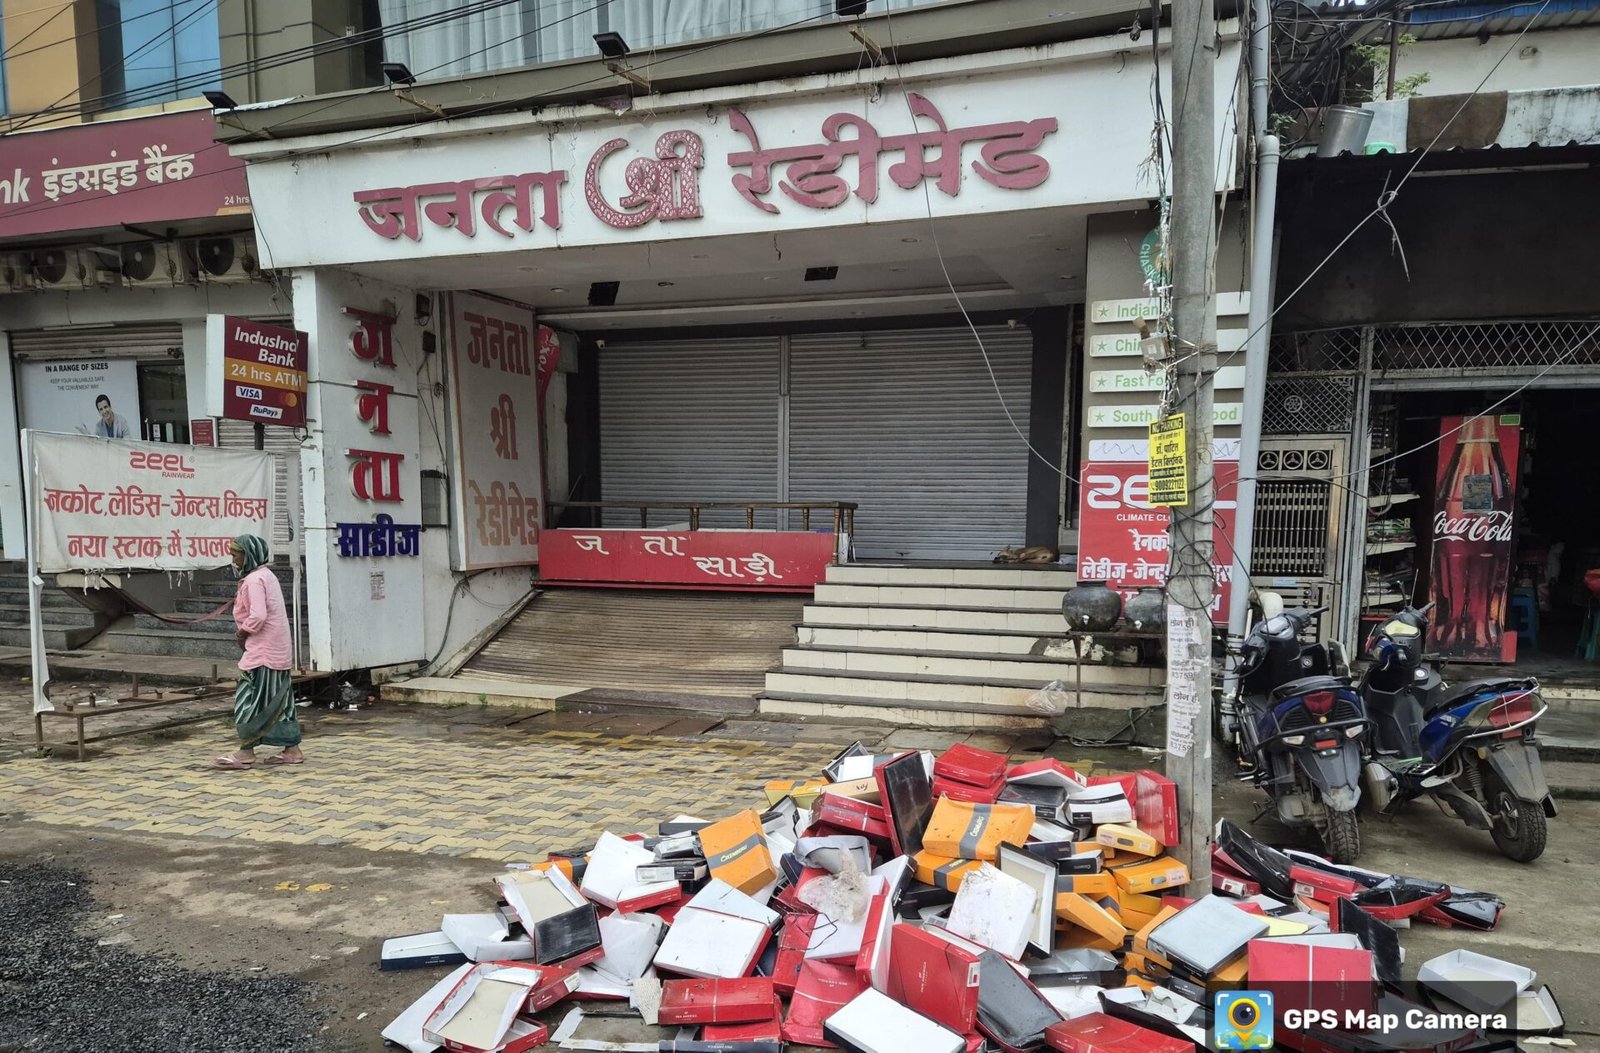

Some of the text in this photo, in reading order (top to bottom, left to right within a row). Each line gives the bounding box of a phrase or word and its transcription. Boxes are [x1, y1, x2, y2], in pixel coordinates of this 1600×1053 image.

[41, 144, 196, 202] इंडसइंड बैंक
[353, 92, 1059, 242] जनता श्री रेडीमेड
[235, 327, 299, 353] IndusInd
[464, 311, 531, 376] जनता
[59, 364, 80, 372] RANGE
[91, 362, 109, 370] SIZES
[258, 348, 295, 368] Bank
[231, 363, 302, 387] 24 hrs ATM
[1115, 374, 1144, 388] Fast
[239, 387, 260, 399] VISA
[1113, 409, 1153, 423] South
[1116, 513, 1154, 521] CLIMATE
[67, 535, 109, 558] नया
[167, 529, 182, 558] में
